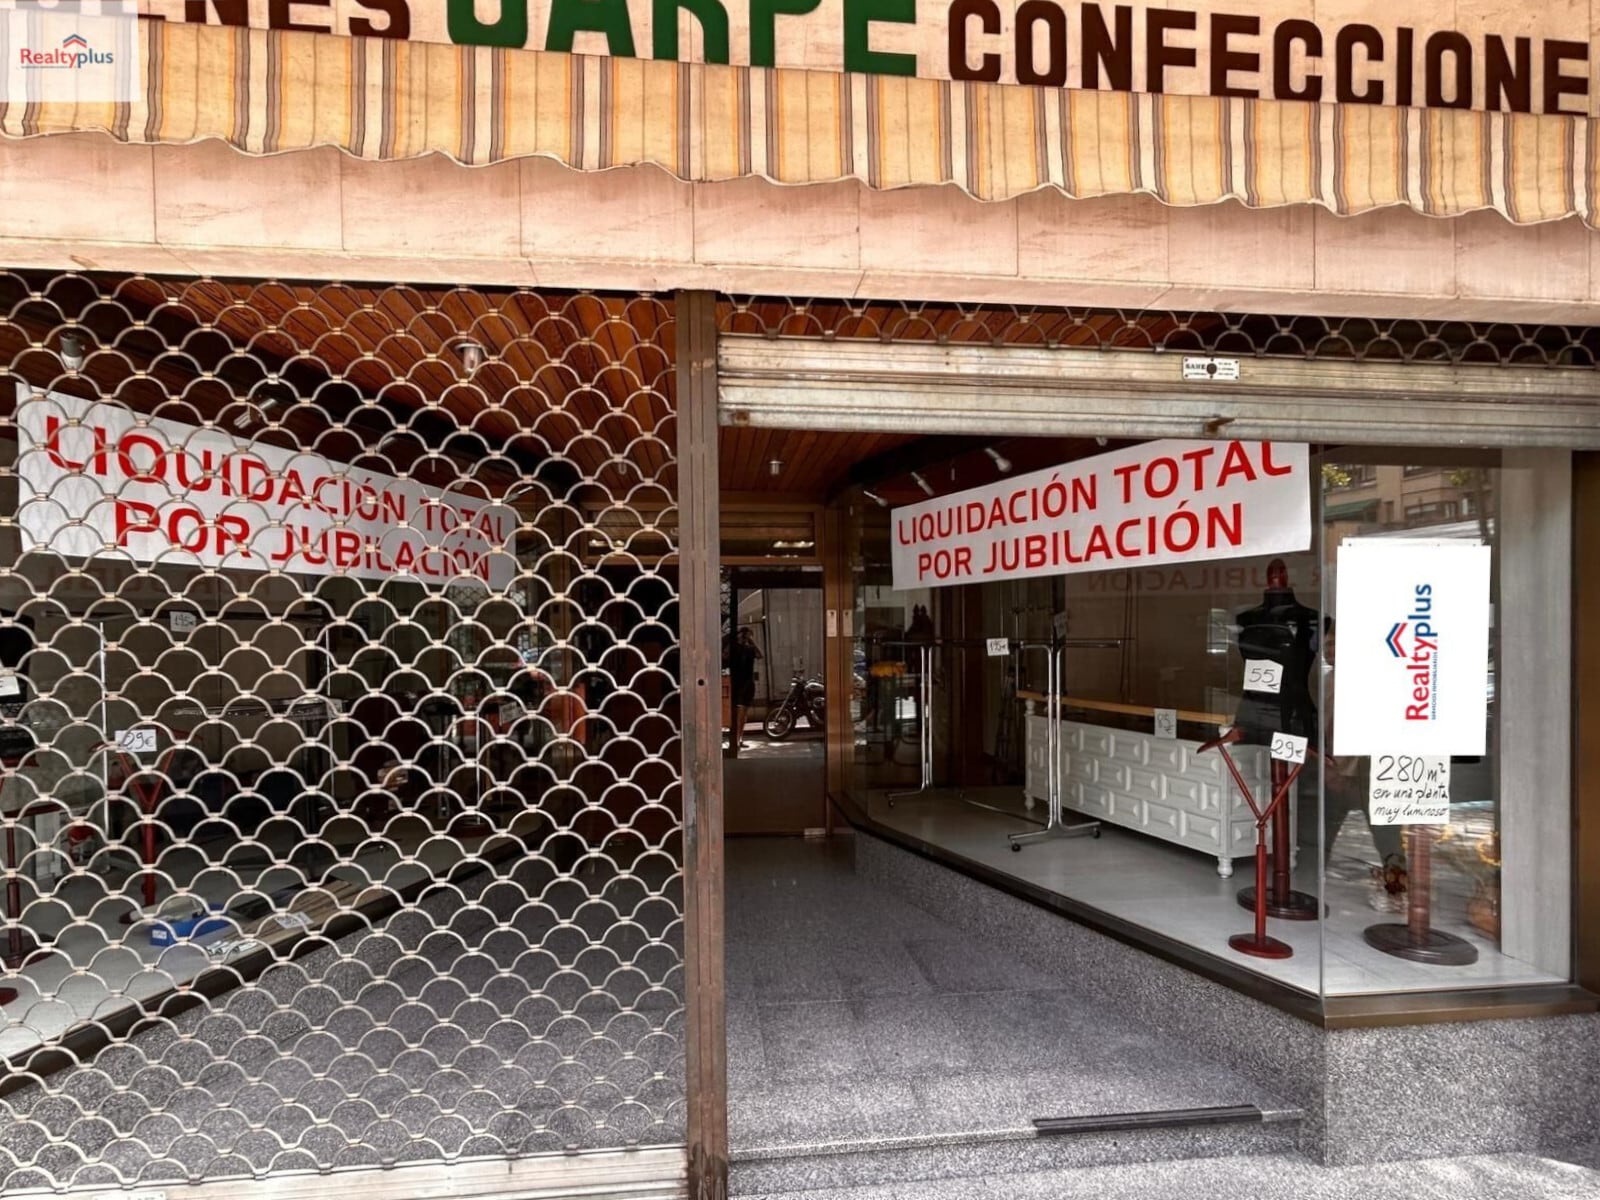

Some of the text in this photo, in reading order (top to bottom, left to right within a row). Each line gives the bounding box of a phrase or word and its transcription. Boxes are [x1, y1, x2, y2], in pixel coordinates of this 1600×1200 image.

[948, 0, 1588, 116] CONFECCIONE
[45, 415, 507, 546] LIQUIDACIÓN TOTAL
[898, 439, 1292, 545] LIQUIDACIÓN TOTAL
[114, 500, 252, 559] POR
[272, 522, 490, 581] JUBILACIÓN
[918, 501, 1243, 582] POR JUBILACIÓN
[1405, 584, 1438, 720] Realtyplus
[1374, 806, 1400, 823] muy
[1376, 755, 1425, 783] 280
